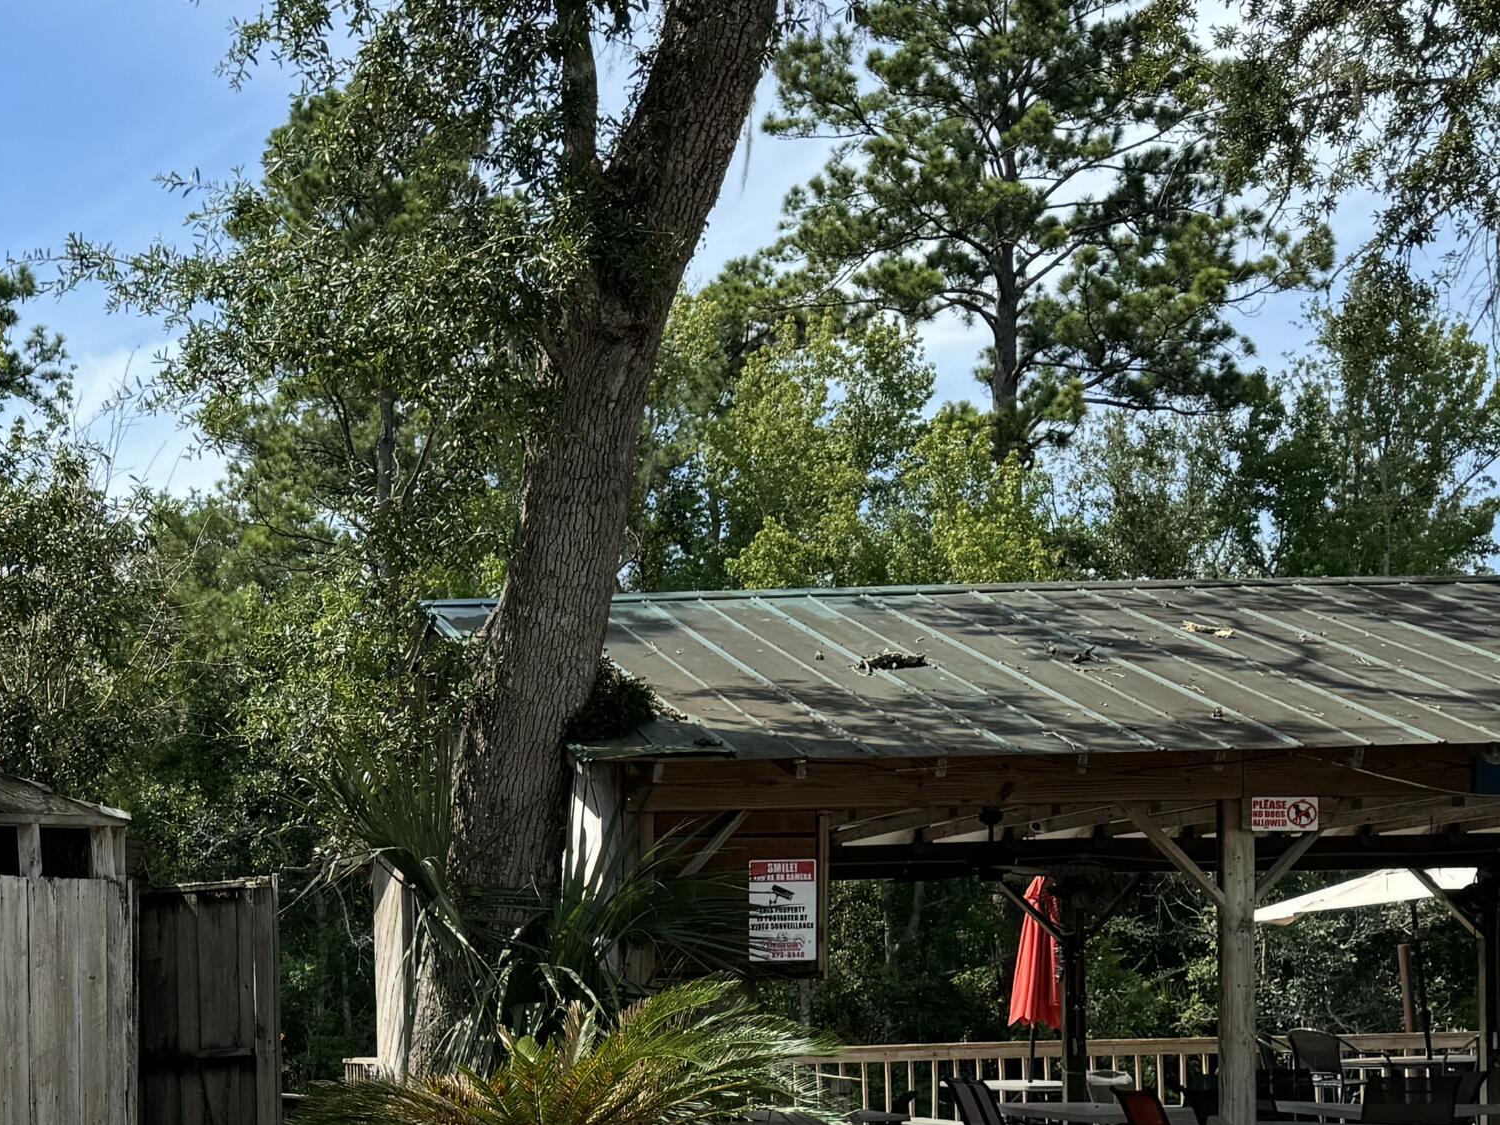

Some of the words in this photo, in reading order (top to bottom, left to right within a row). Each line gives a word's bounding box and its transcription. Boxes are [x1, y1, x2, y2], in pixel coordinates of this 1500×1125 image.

[1252, 800, 1287, 810] PLEASE
[1252, 819, 1287, 827] ALLOWED
[767, 863, 798, 873] SMILE!
[770, 922, 814, 930] SURVEILLANCE
